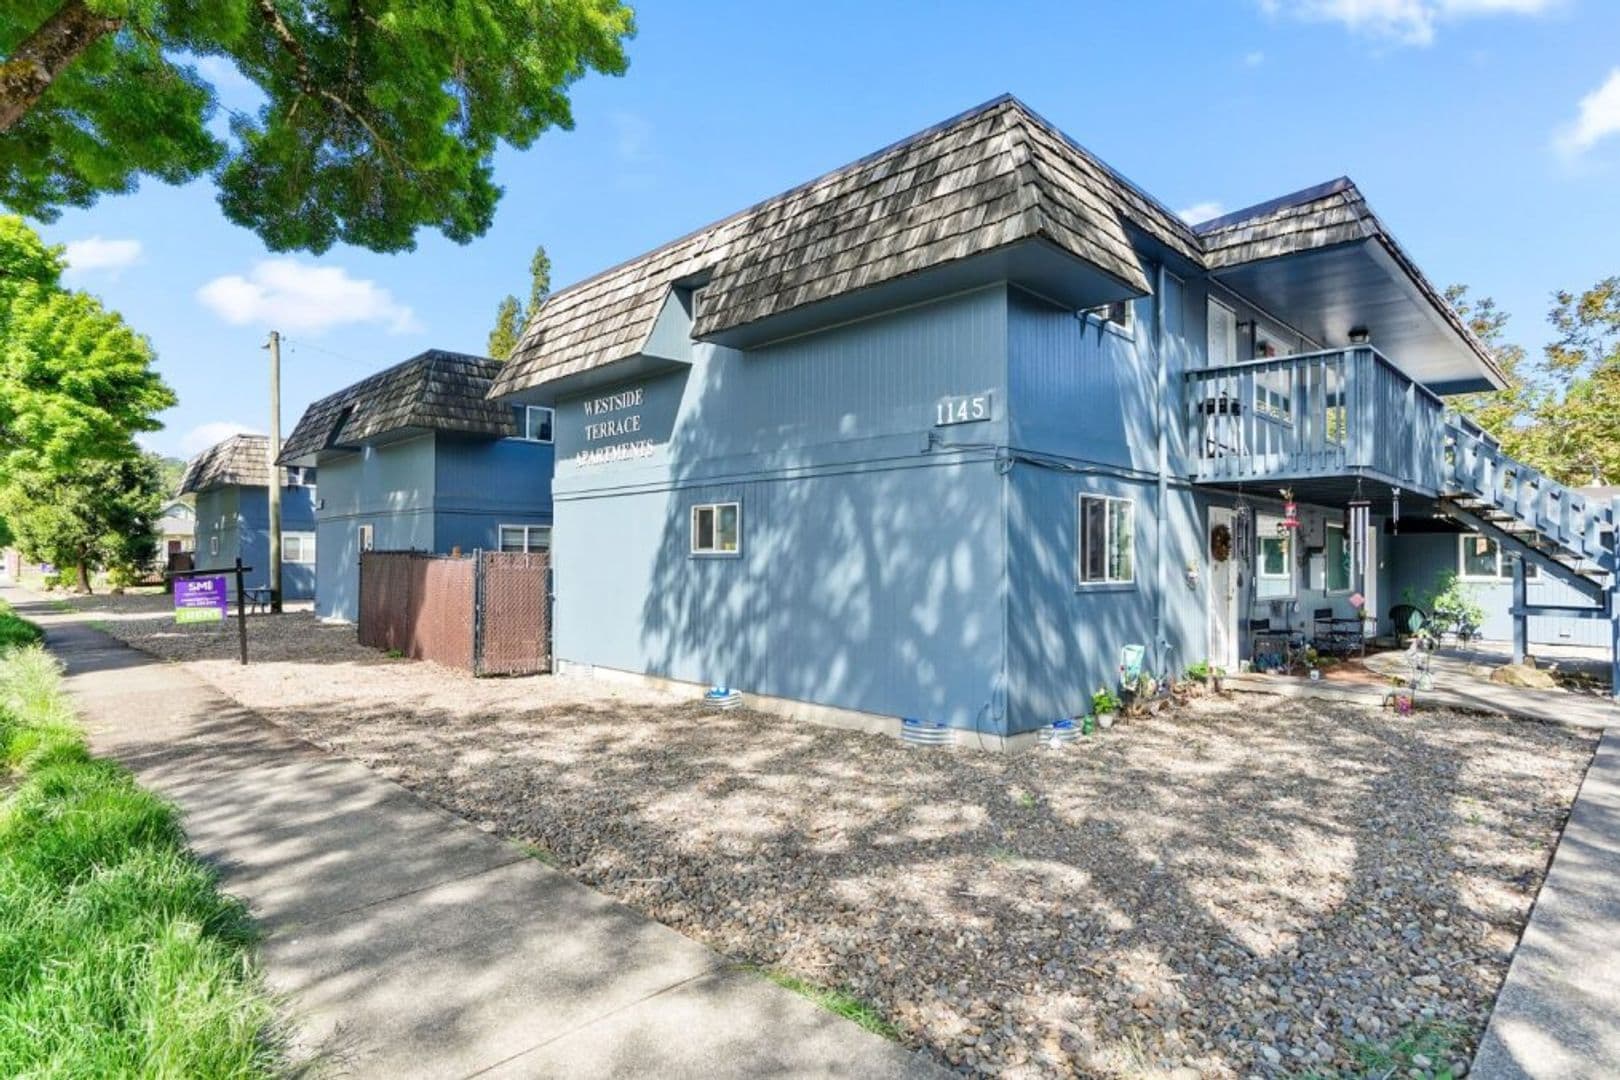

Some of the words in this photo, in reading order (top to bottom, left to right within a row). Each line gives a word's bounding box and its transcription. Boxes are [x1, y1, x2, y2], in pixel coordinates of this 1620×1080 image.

[584, 388, 643, 416] WESTSIDE
[936, 397, 985, 425] 1145
[585, 415, 641, 441] TERRACE
[576, 438, 654, 467] APARTMENTS
